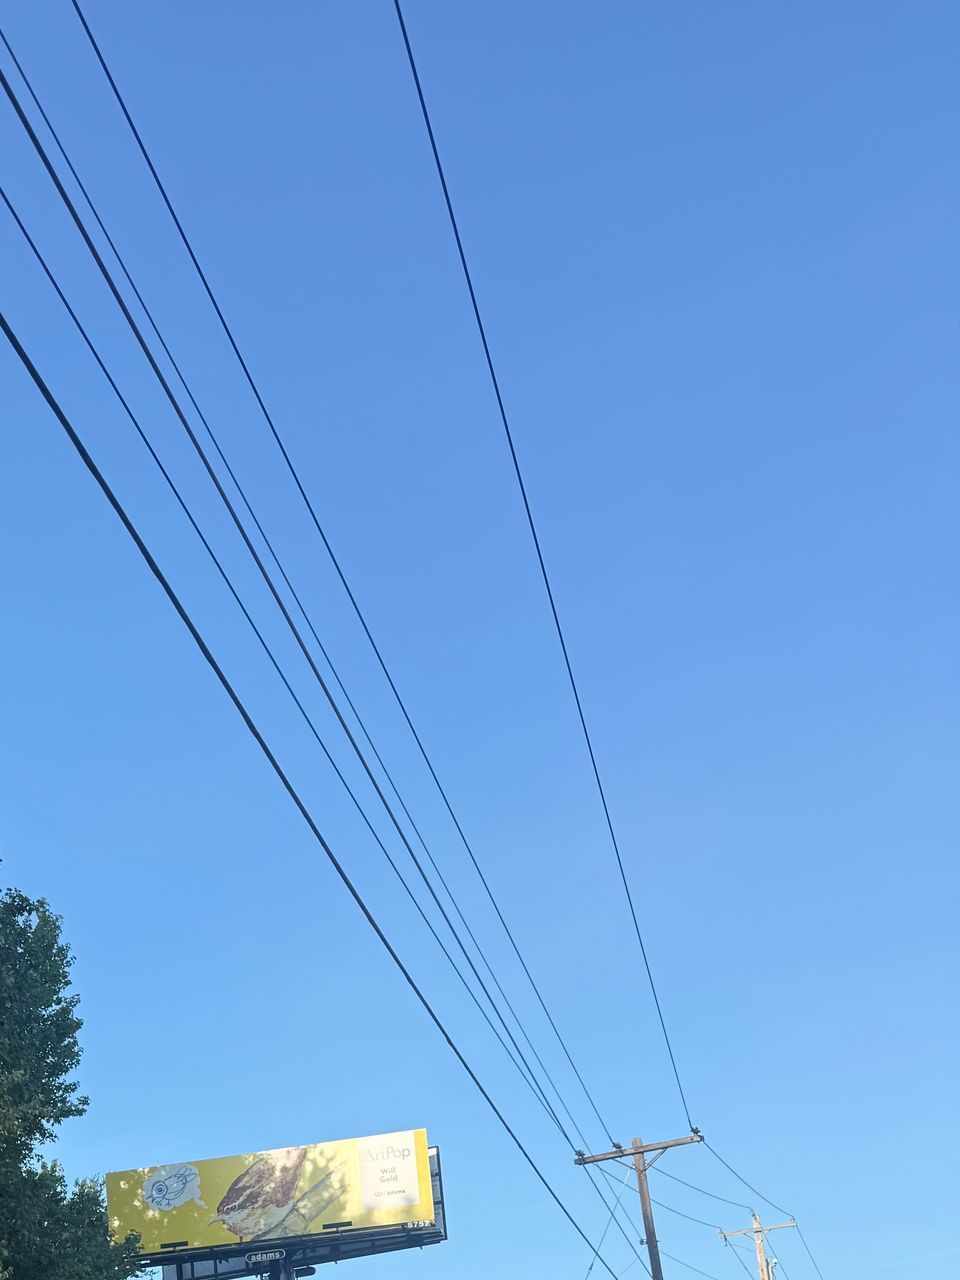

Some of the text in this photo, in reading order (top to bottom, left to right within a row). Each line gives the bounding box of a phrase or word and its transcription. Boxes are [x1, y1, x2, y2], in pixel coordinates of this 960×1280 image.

[364, 1146, 411, 1163] ArtPop
[380, 1166, 396, 1174] Will
[379, 1174, 398, 1183] Gold
[407, 1220, 430, 1229] 8757
[250, 1251, 280, 1261] adams
